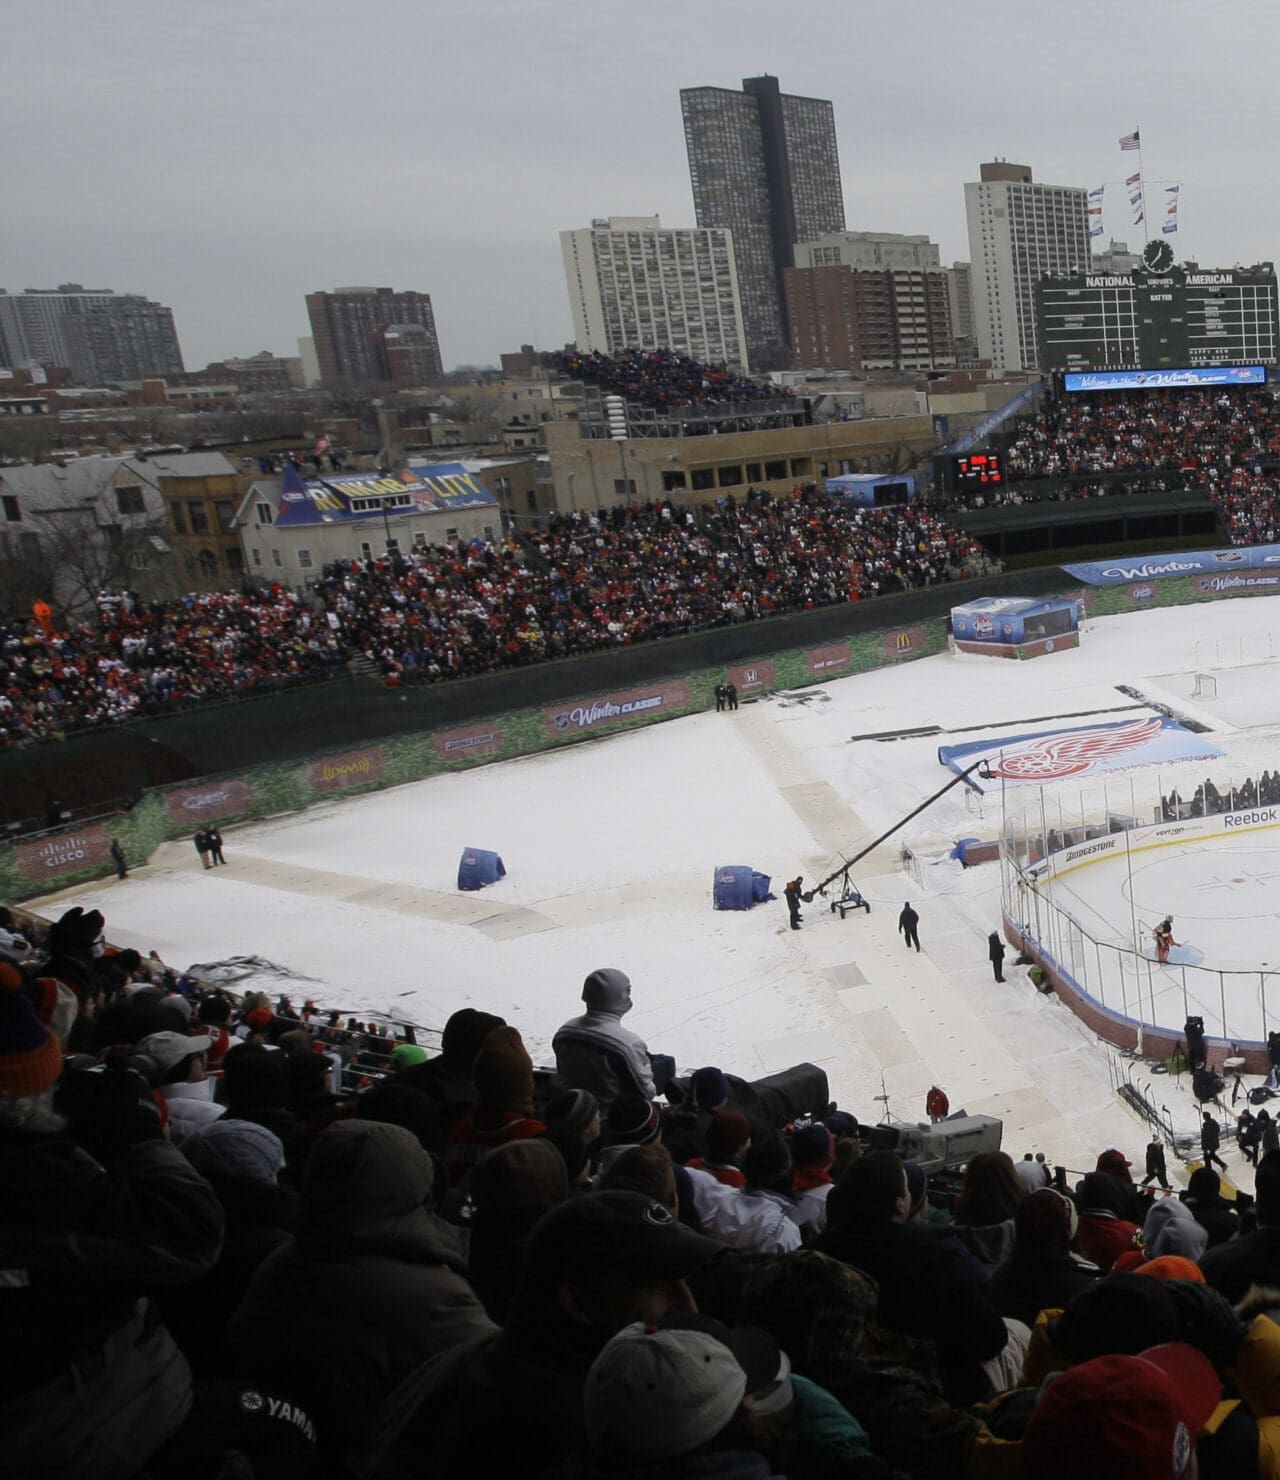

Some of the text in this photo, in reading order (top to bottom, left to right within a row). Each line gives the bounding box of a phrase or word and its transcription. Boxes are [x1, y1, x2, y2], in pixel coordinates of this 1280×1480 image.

[1086, 276, 1136, 287] NATIONAL
[1185, 274, 1233, 285] AMERICAN
[1147, 371, 1197, 385] Winter
[1102, 561, 1203, 579] Winter
[1211, 575, 1247, 591] Winter
[1246, 577, 1280, 586] CLASSIC
[571, 700, 621, 727] Winter
[621, 696, 663, 714] CLASSIC
[1224, 808, 1278, 828] Reebok
[1155, 826, 1185, 837] verizon
[47, 850, 85, 867] CISCO
[1065, 838, 1117, 863] BRIDGESTONE
